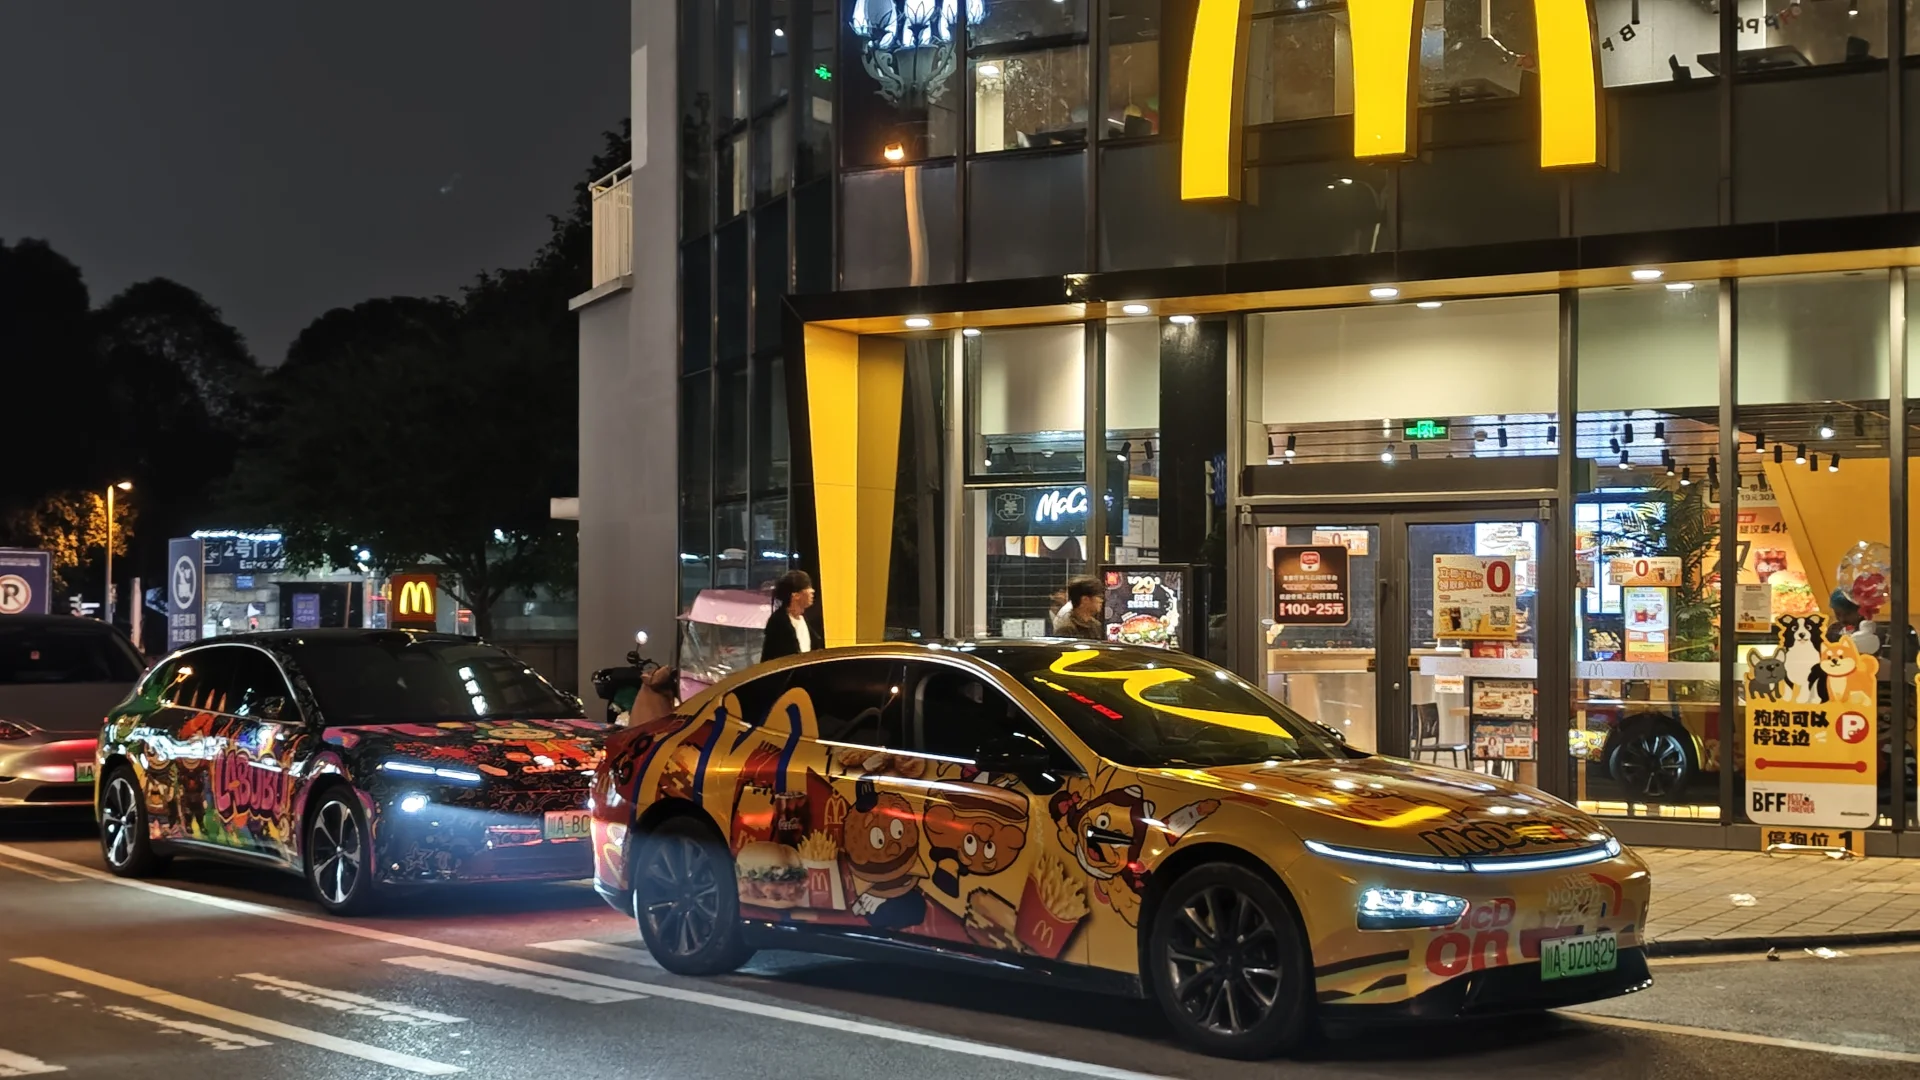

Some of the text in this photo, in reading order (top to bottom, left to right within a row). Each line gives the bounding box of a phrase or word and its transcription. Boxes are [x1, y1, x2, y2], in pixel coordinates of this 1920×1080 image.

[1754, 708, 1830, 728] 狗狗可以
[1753, 728, 1811, 746] 停这边
[214, 748, 290, 820] LABUBU
[1752, 791, 1787, 813] BFF
[1838, 830, 1853, 851] 1
[1546, 883, 1603, 908] NORTH
